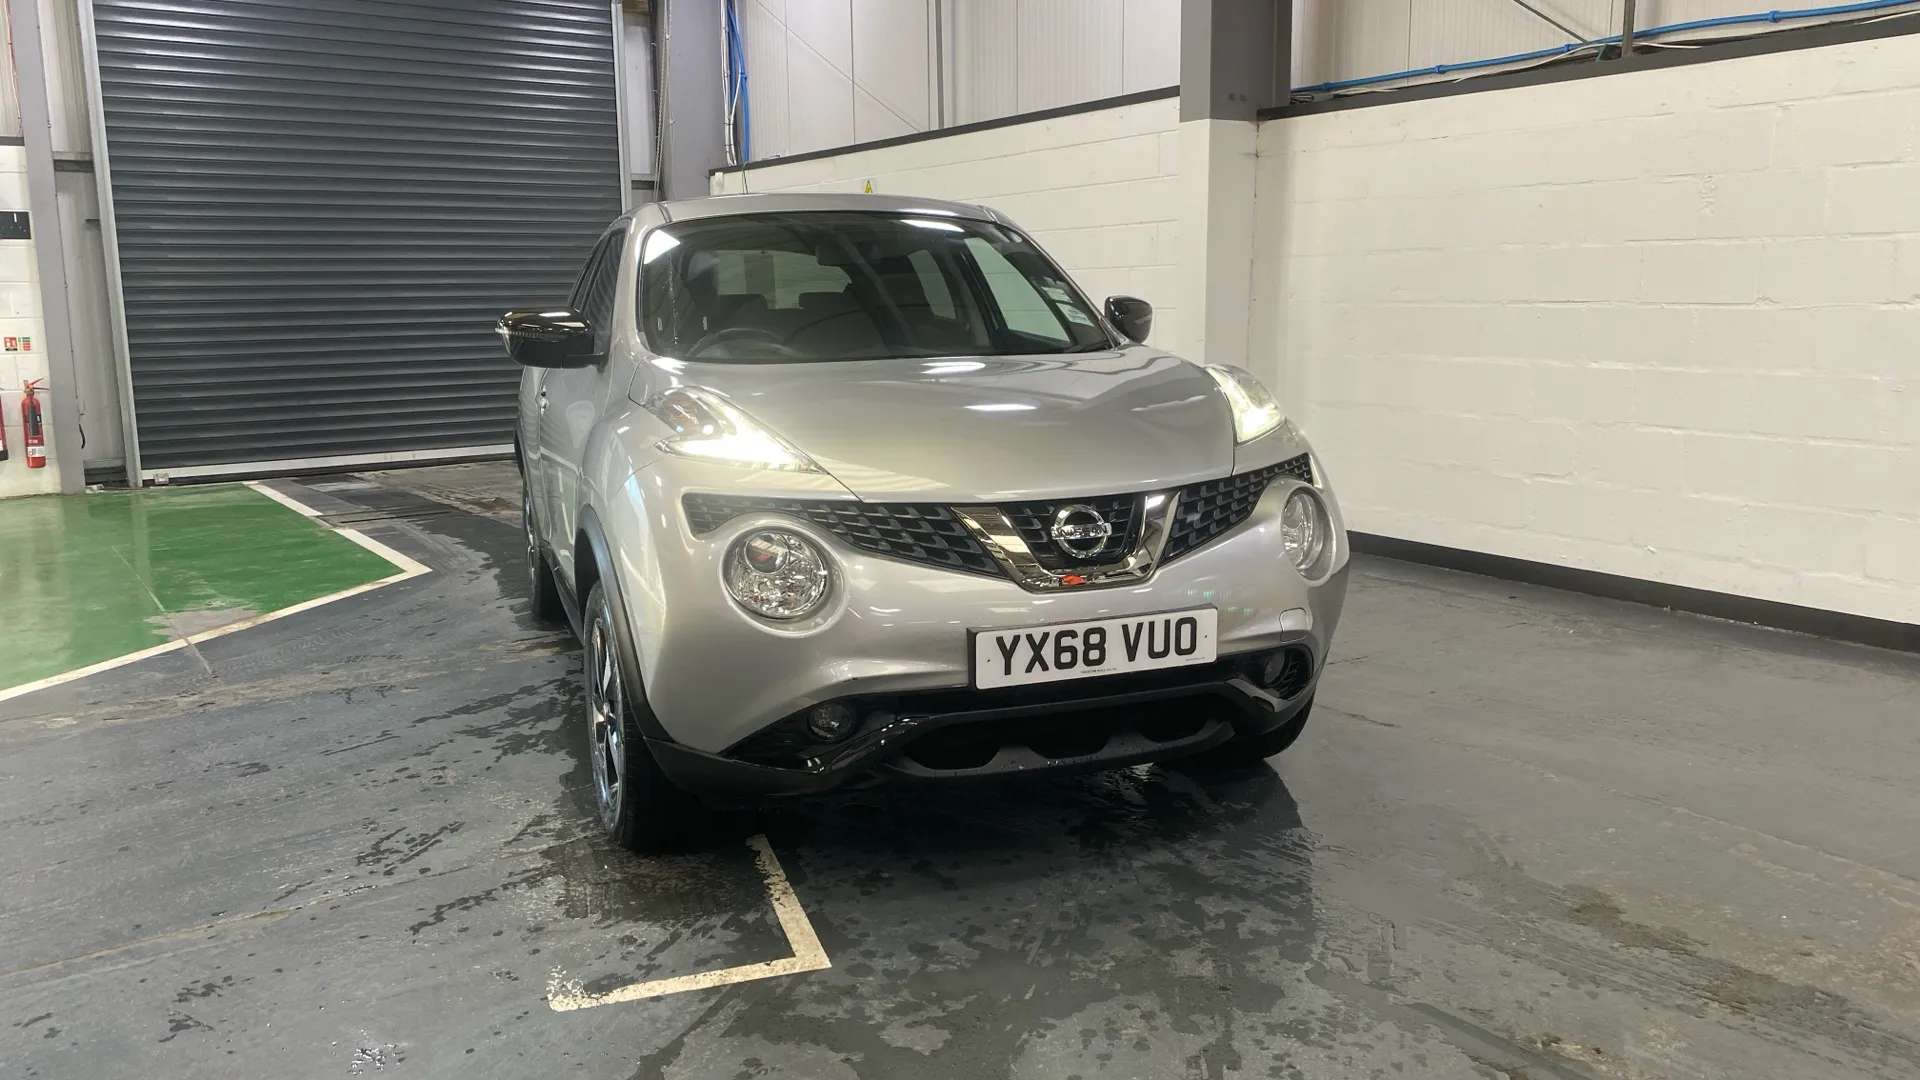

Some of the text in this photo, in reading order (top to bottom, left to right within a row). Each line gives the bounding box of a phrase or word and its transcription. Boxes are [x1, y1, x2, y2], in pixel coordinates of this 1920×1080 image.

[1056, 525, 1108, 537] NISSAN
[996, 617, 1198, 676] YX68 VUO
